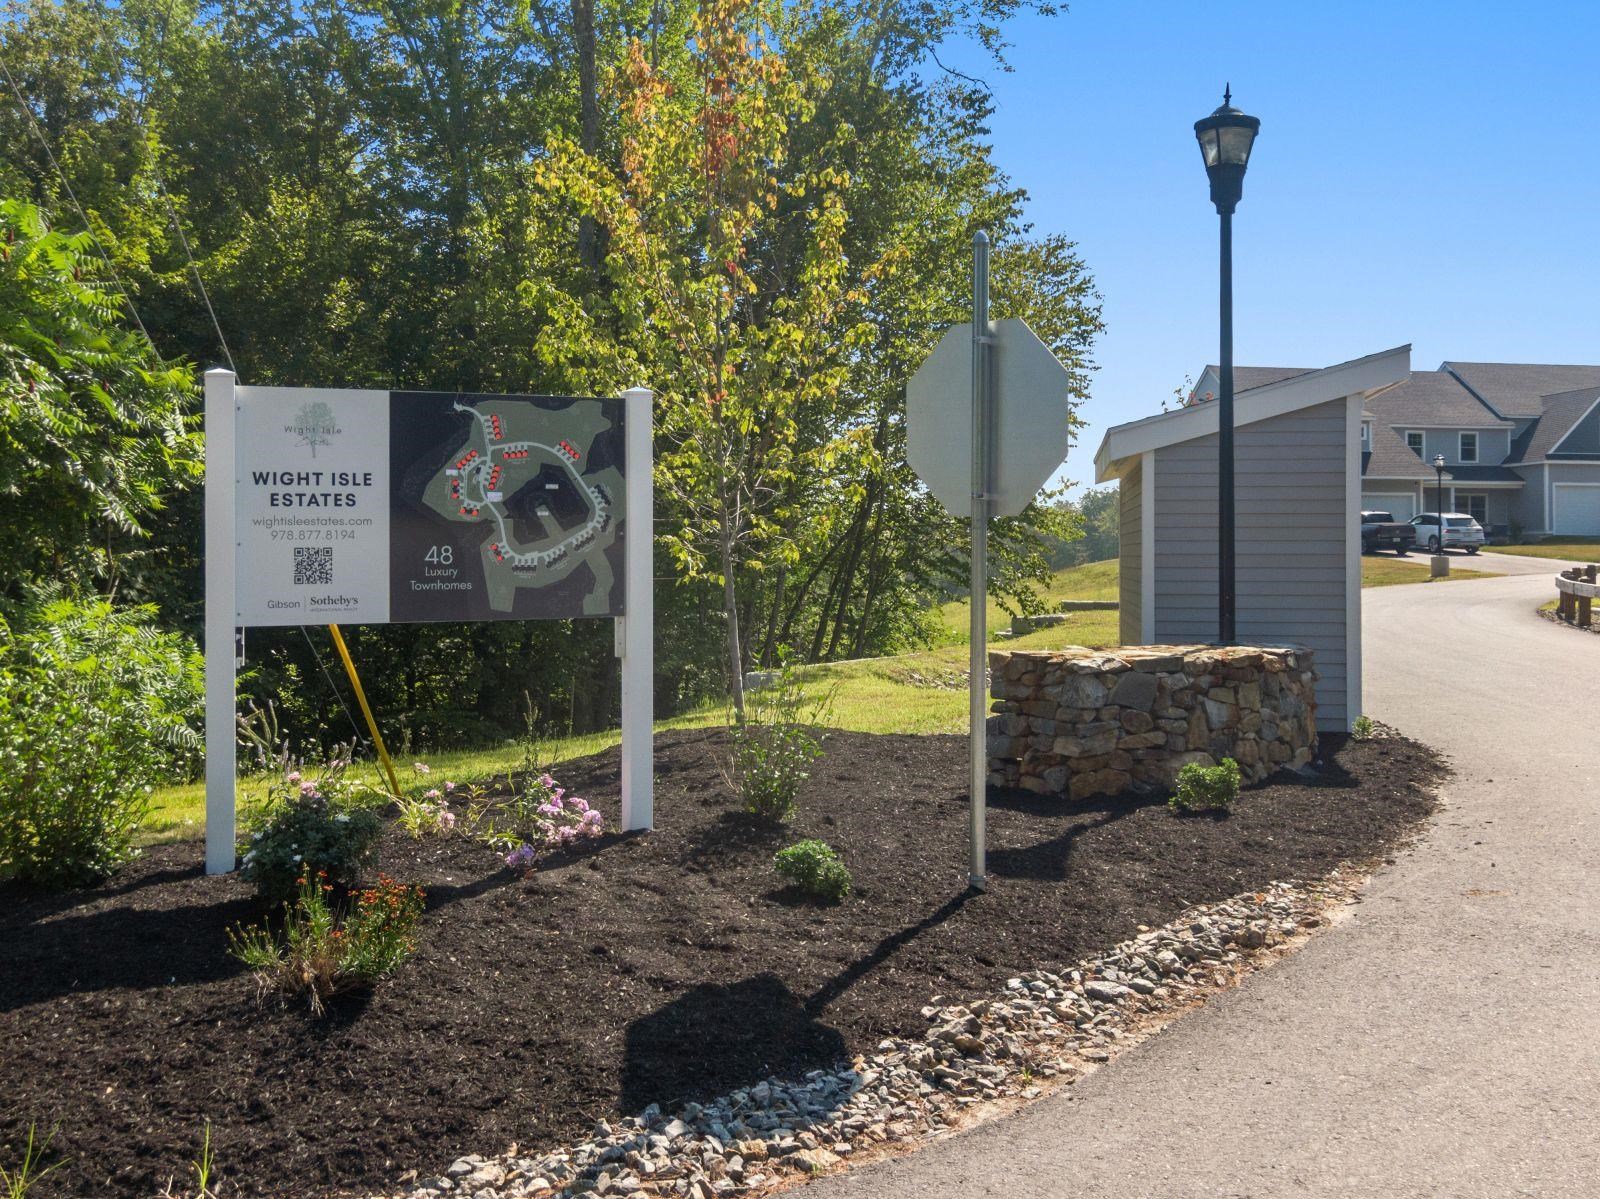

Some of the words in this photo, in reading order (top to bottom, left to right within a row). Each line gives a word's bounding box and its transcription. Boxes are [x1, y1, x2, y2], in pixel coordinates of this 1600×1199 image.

[252, 471, 324, 486] WIGHT
[331, 472, 373, 487] ISLE
[270, 492, 357, 507] ESTATES
[252, 514, 373, 529] wightisleestates.com
[271, 530, 356, 541] 978.877.8194
[424, 545, 453, 565] 48
[425, 566, 458, 579] Luxury
[410, 579, 473, 591] Townhomes
[267, 599, 301, 609] Gibson
[310, 594, 359, 607] Sotheby's
